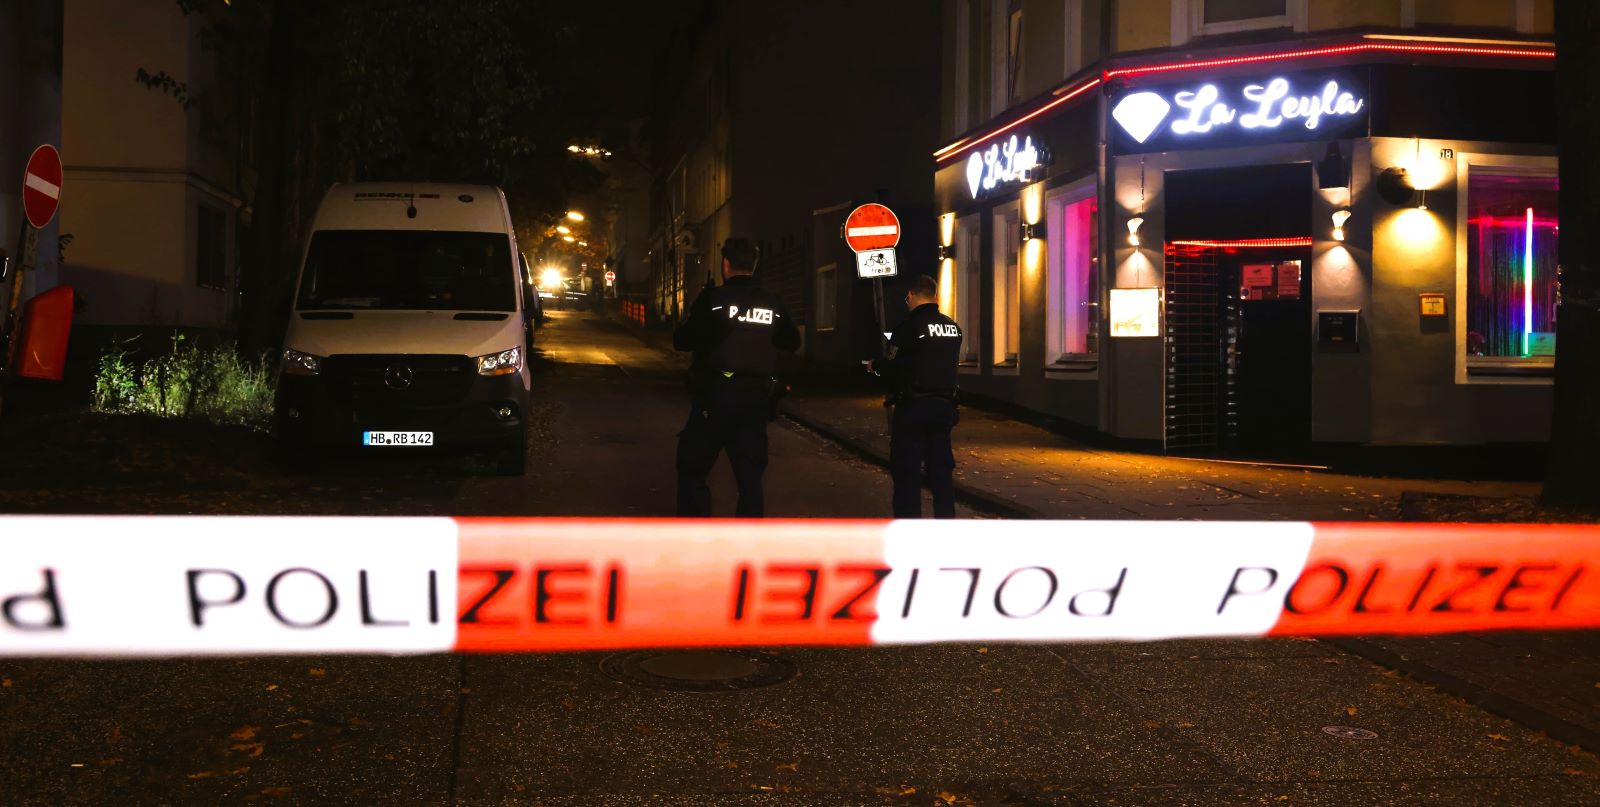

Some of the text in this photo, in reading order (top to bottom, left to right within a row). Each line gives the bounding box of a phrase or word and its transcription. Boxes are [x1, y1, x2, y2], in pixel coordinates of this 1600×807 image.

[1171, 78, 1364, 135] La Leyla
[1440, 148, 1453, 159] 18
[927, 323, 959, 337] POLIZEI
[370, 432, 432, 444] HB RB 142
[186, 567, 619, 630] POLIZEI
[733, 566, 1128, 622] POLIZEI
[1216, 563, 1585, 617] POLIZEI
